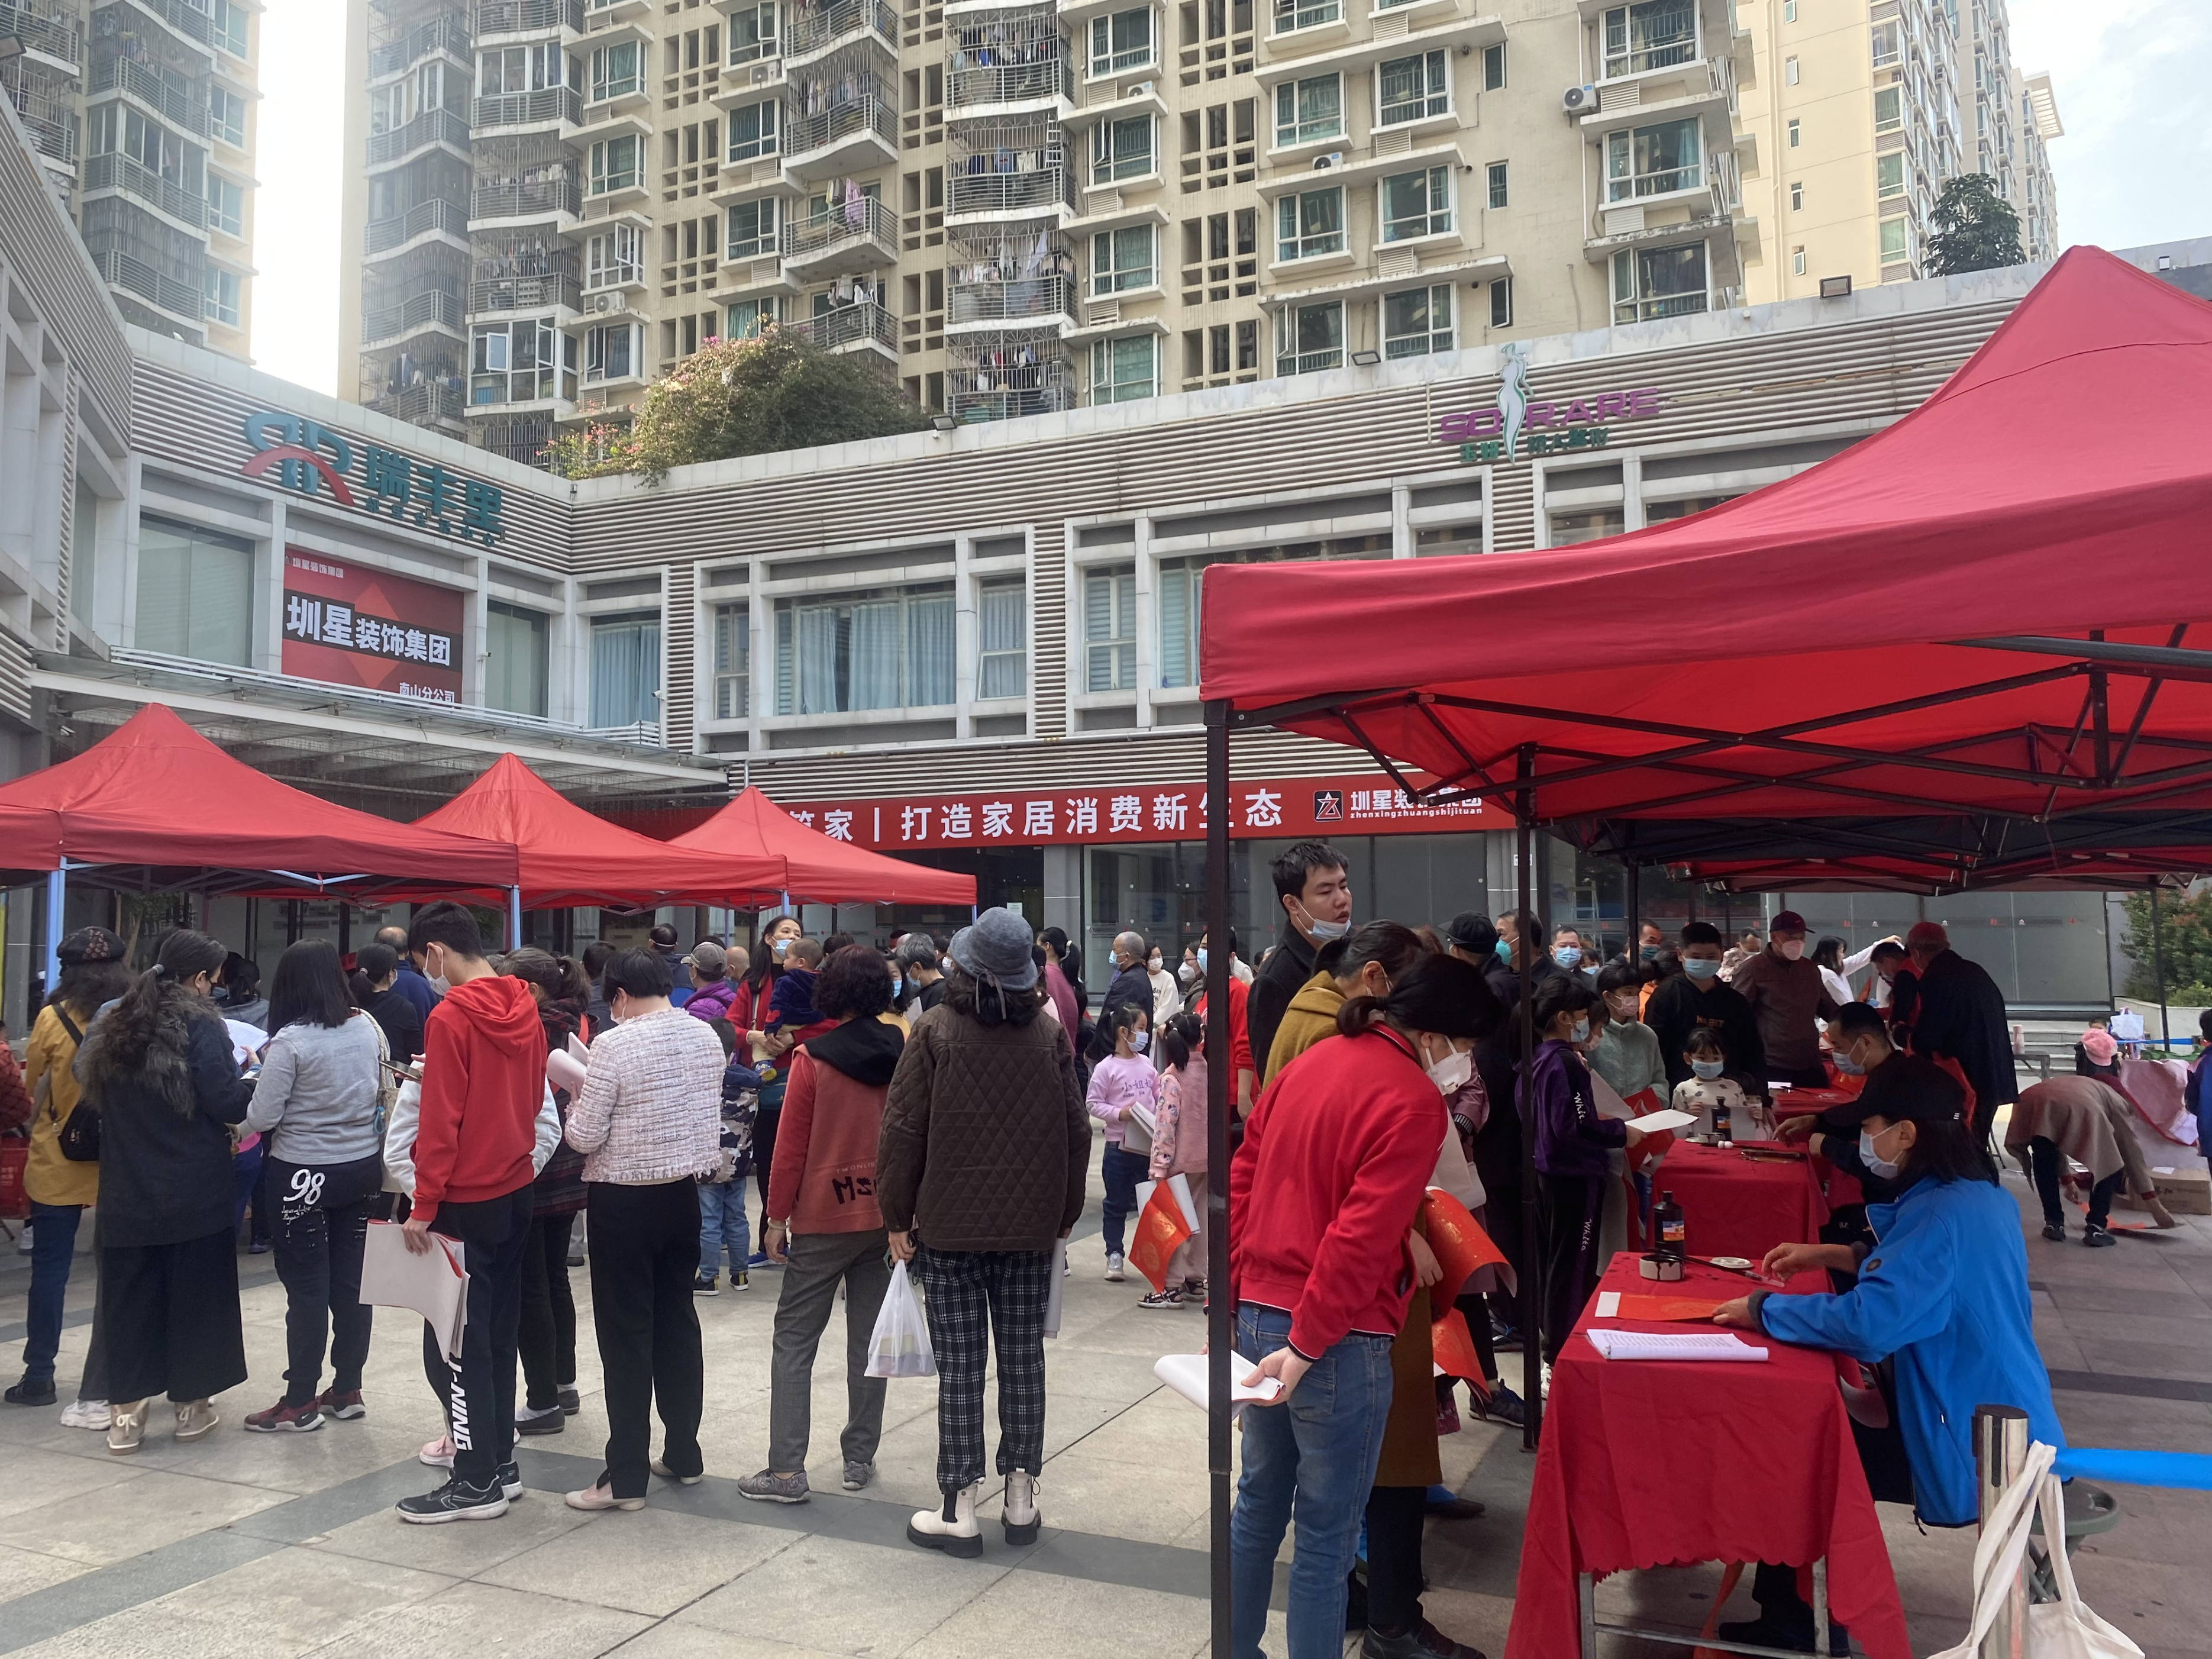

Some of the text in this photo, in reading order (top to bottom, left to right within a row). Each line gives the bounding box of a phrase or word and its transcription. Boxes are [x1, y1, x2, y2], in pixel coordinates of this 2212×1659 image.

[1439, 388, 1659, 441] SO RARE
[363, 446, 502, 532] 瑞丰里
[292, 557, 344, 578] 圳星装饰集团
[286, 596, 450, 666] 圳星装饰集团
[399, 682, 454, 703] 南山分公司
[1350, 808, 1482, 819] zhenxingzhuangshijituan
[1574, 1092, 1585, 1124] Whit
[283, 1169, 325, 1205] 98
[448, 1358, 473, 1451] I-NING
